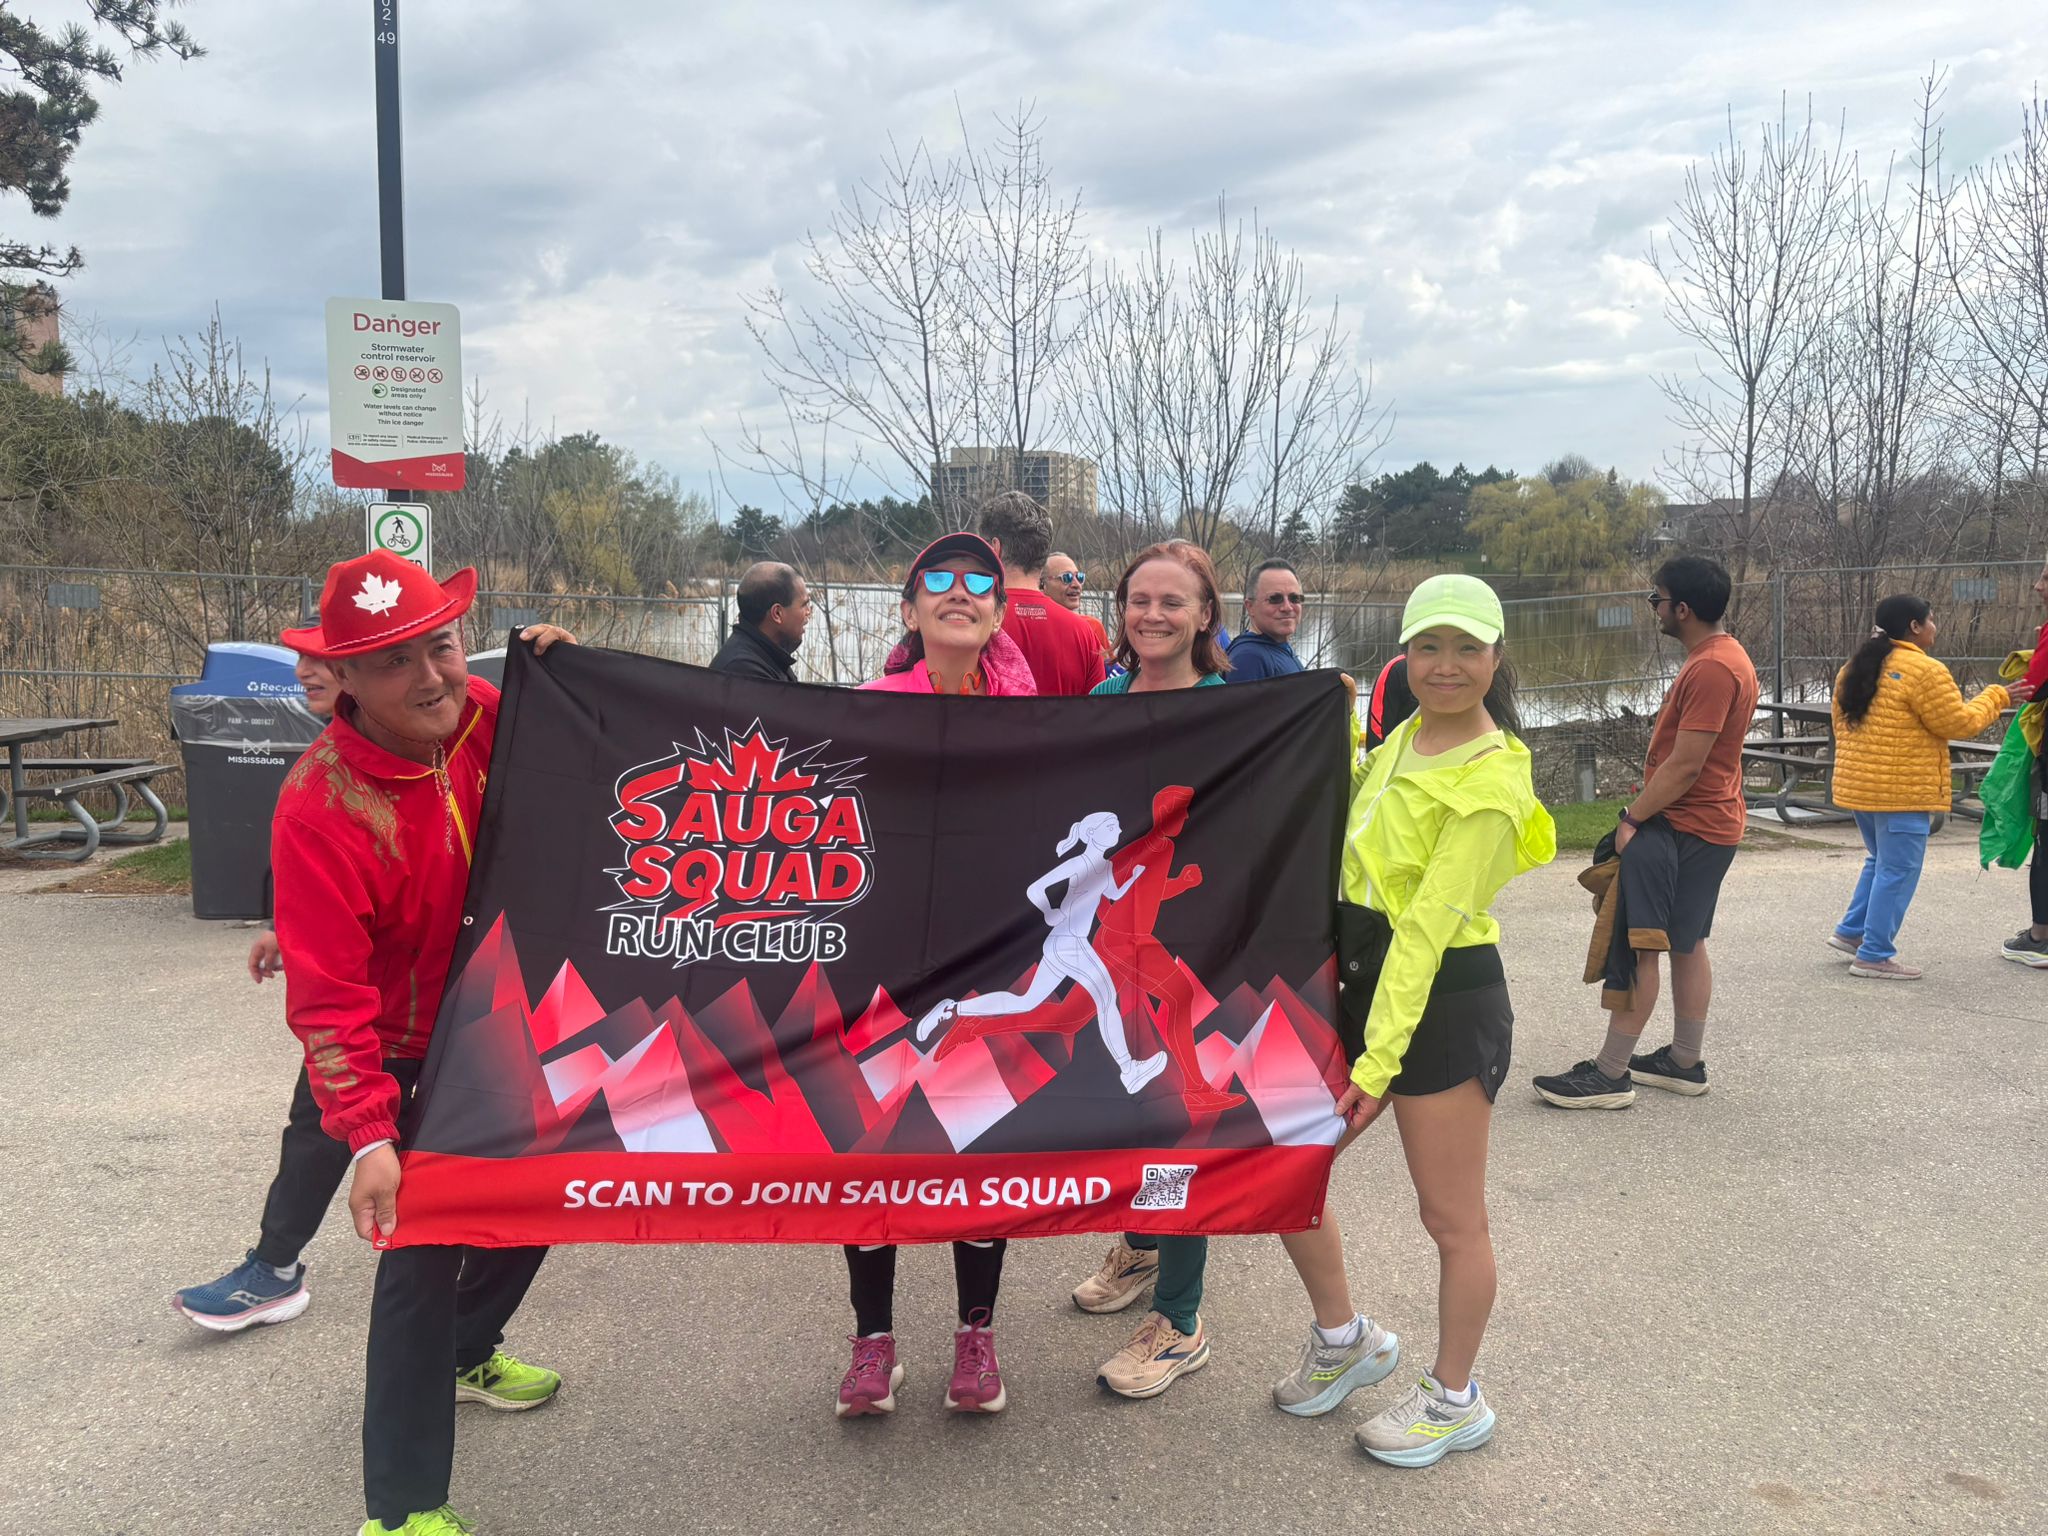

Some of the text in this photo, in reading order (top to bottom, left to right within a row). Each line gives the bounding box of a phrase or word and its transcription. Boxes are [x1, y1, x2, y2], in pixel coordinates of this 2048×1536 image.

[377, 32, 395, 44] 49
[353, 313, 441, 337] Danger
[371, 343, 425, 353] Stormwater
[360, 353, 436, 363] control reservoir
[391, 386, 426, 394] Designated
[260, 683, 307, 693] Recyclin
[614, 763, 866, 846] SAUGA
[622, 845, 867, 918] SQUAD
[606, 913, 846, 963] RUN CLUB
[564, 1176, 1112, 1209] SCAN TO JOIN SAUGA SQUAD
